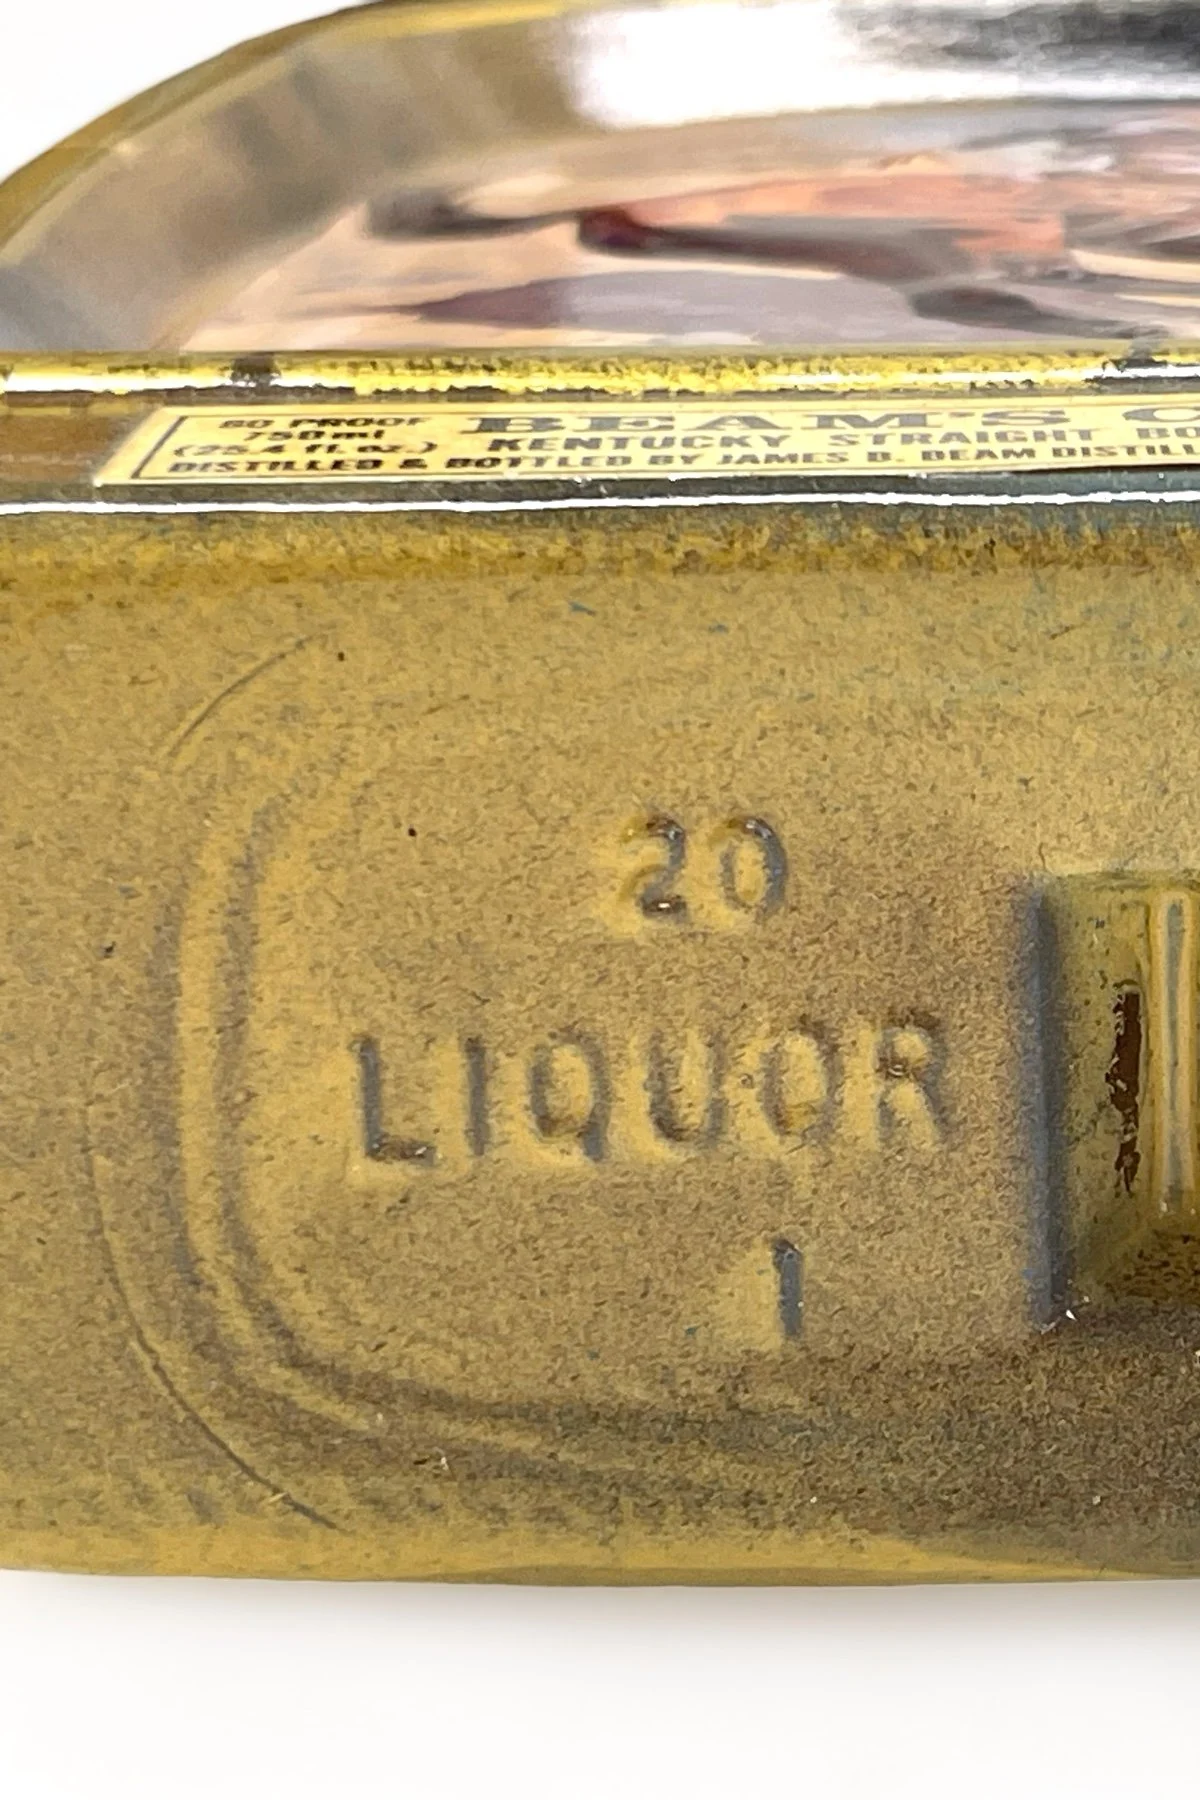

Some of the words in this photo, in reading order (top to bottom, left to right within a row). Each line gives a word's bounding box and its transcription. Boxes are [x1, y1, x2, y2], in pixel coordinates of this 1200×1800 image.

[288, 417, 431, 428] PROOF
[460, 410, 1071, 434] BEAM'S
[488, 434, 791, 451] KENTUCKY
[828, 428, 1104, 447] STRAIGHT
[168, 458, 384, 473] DISTILLED
[398, 458, 429, 469] &
[445, 454, 633, 468] BOTTLED
[648, 453, 705, 465] BY
[716, 451, 850, 465] JAMES
[920, 447, 1037, 461] BEAM
[618, 814, 789, 920] 20
[352, 1004, 949, 1168] LIQUOR
